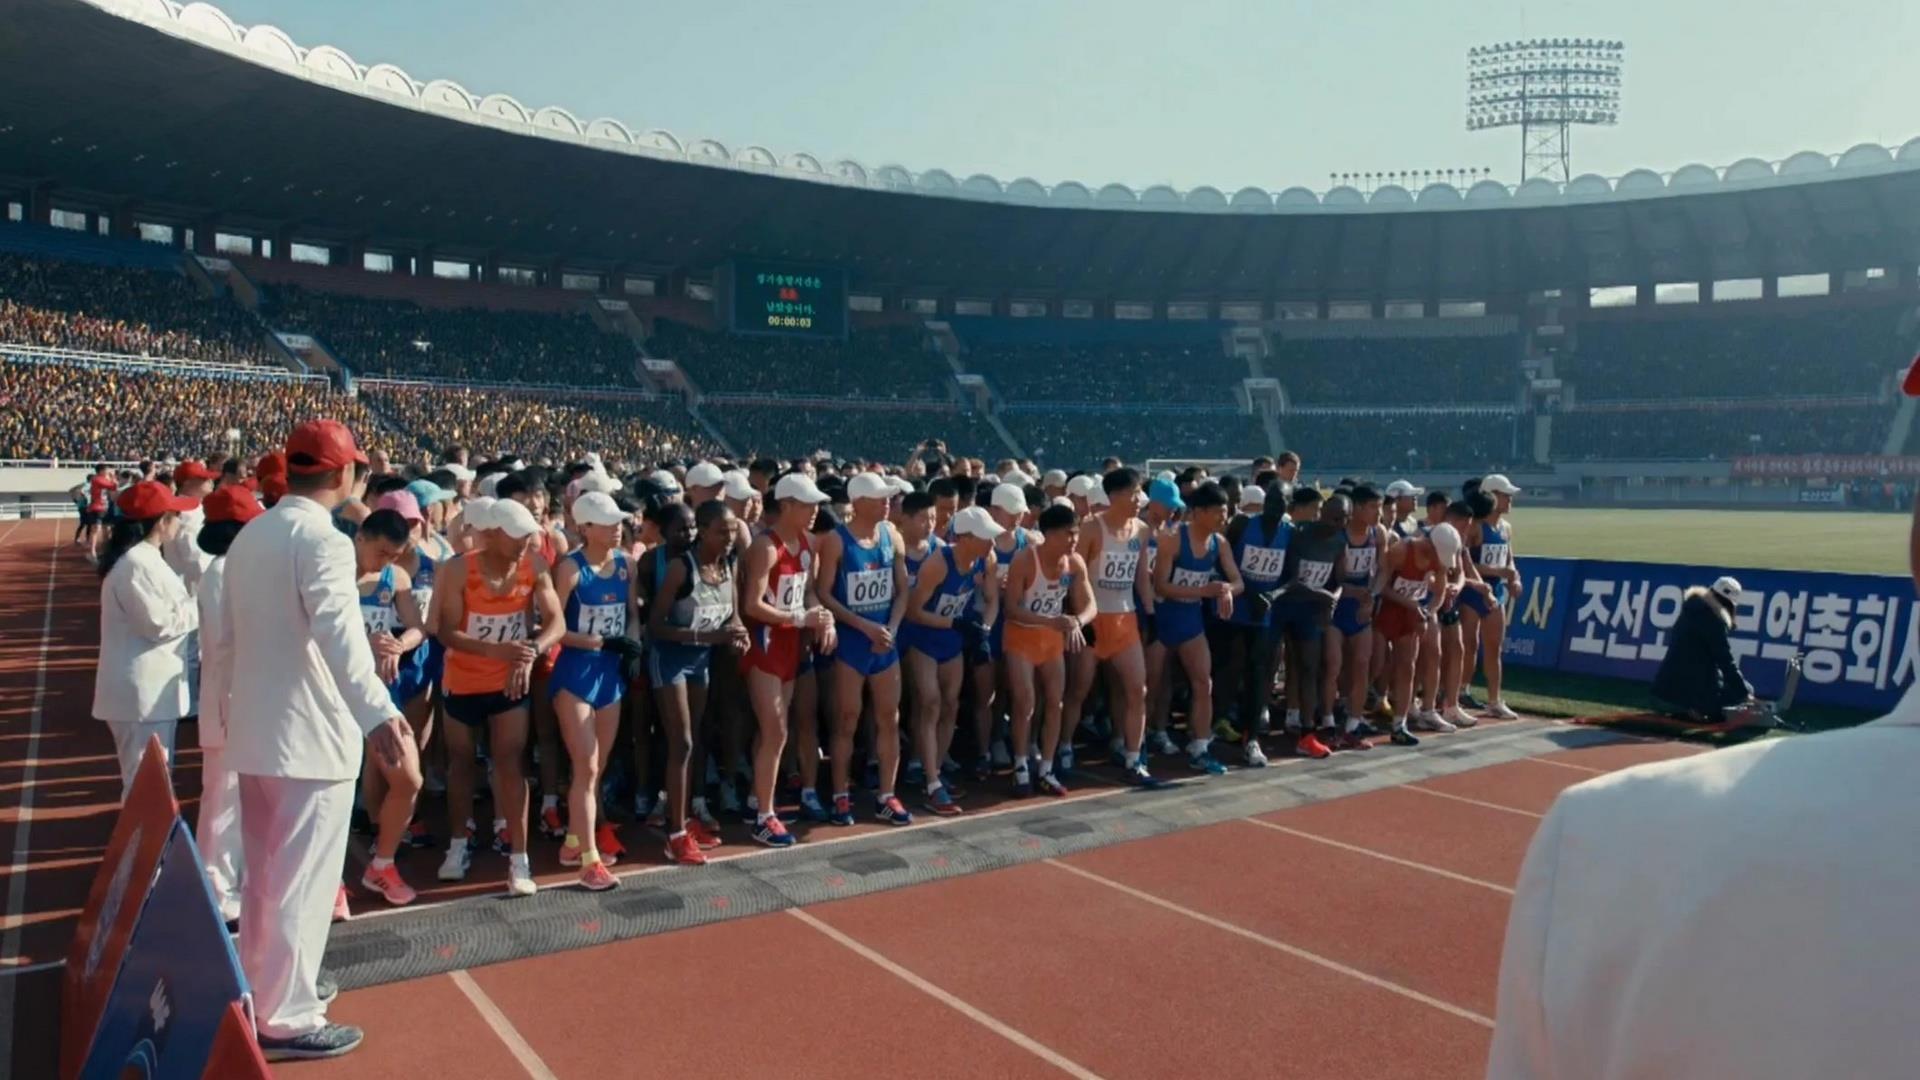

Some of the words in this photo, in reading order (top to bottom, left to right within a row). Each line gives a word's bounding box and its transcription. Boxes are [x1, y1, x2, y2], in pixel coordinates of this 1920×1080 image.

[768, 315, 811, 328] 00:00:03
[1105, 561, 1136, 579] 056
[1246, 555, 1279, 574] 216
[855, 579, 888, 602] 006
[1569, 578, 1915, 690] 조선오무역총회
